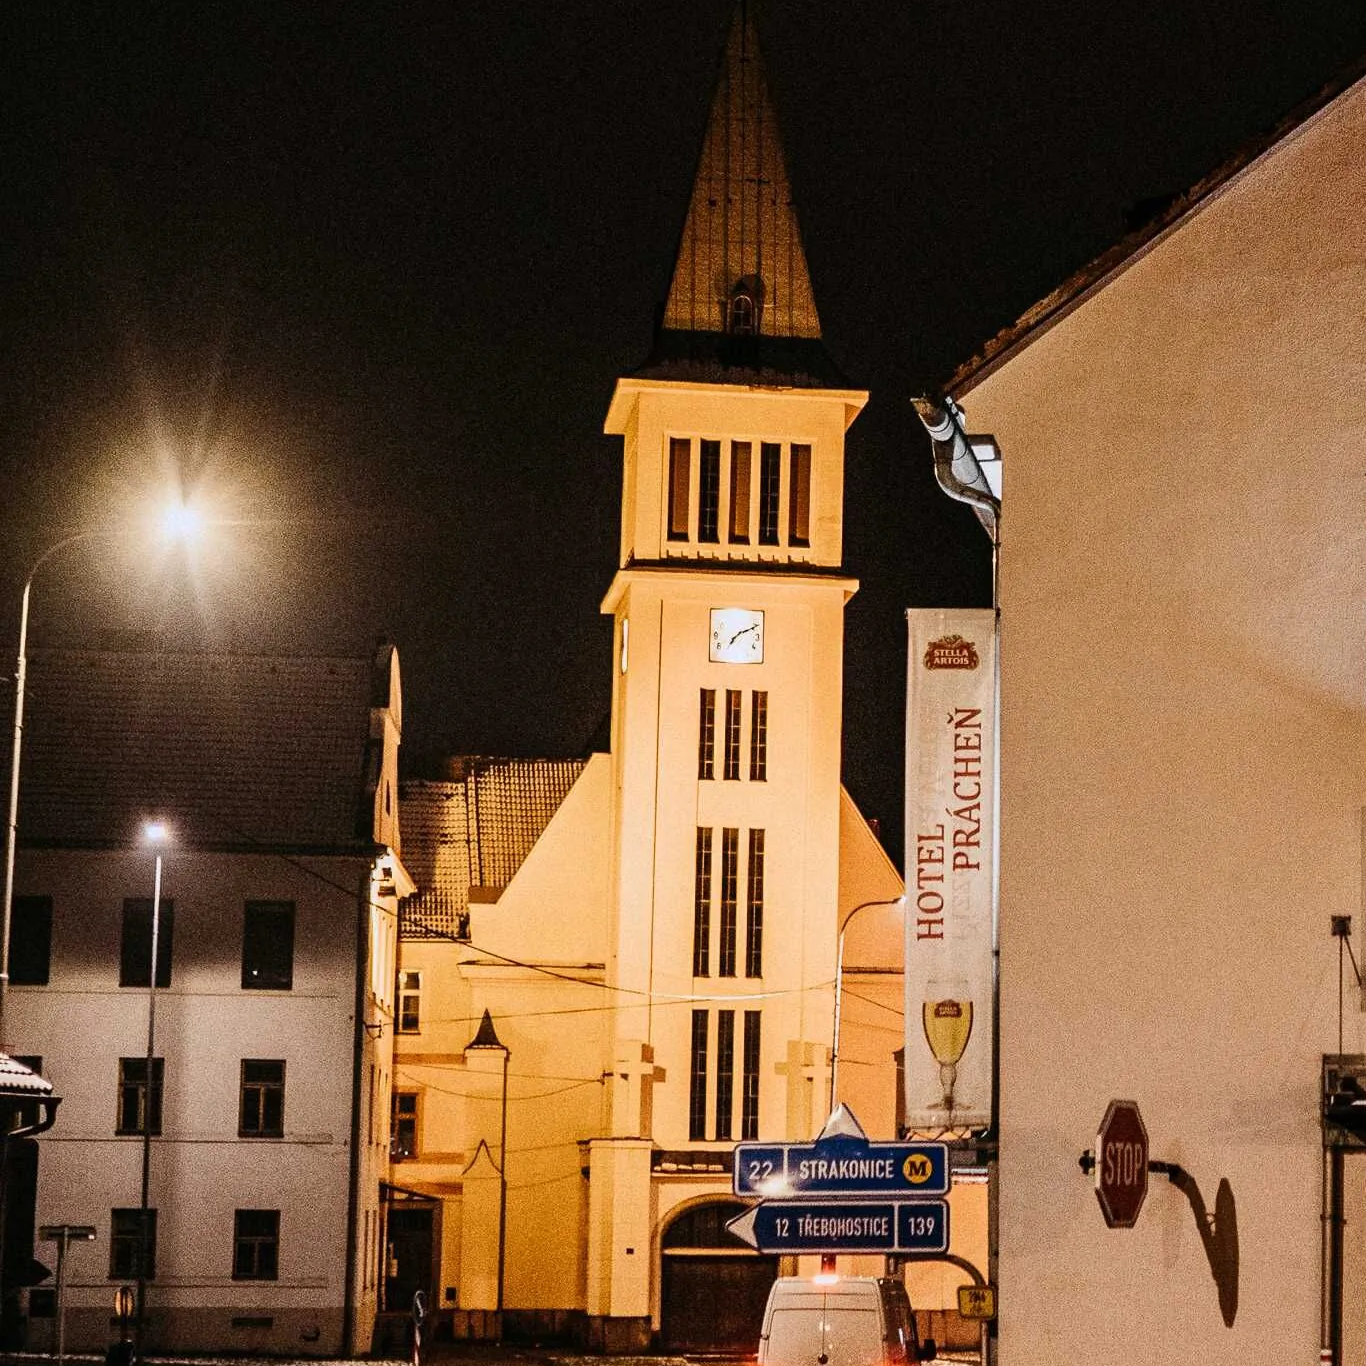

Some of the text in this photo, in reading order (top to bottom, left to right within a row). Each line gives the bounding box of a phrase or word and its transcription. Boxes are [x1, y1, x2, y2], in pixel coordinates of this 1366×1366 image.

[933, 657, 969, 665] ARTOIS
[946, 707, 982, 871] PRÁCHEŇ
[917, 824, 945, 941] HOTEL
[749, 1161, 773, 1180] 22
[799, 1159, 894, 1180] STRAKONICE
[1105, 1142, 1143, 1186] STOP
[775, 1214, 935, 1236] 12 TŘEBOHOSTICE 139
